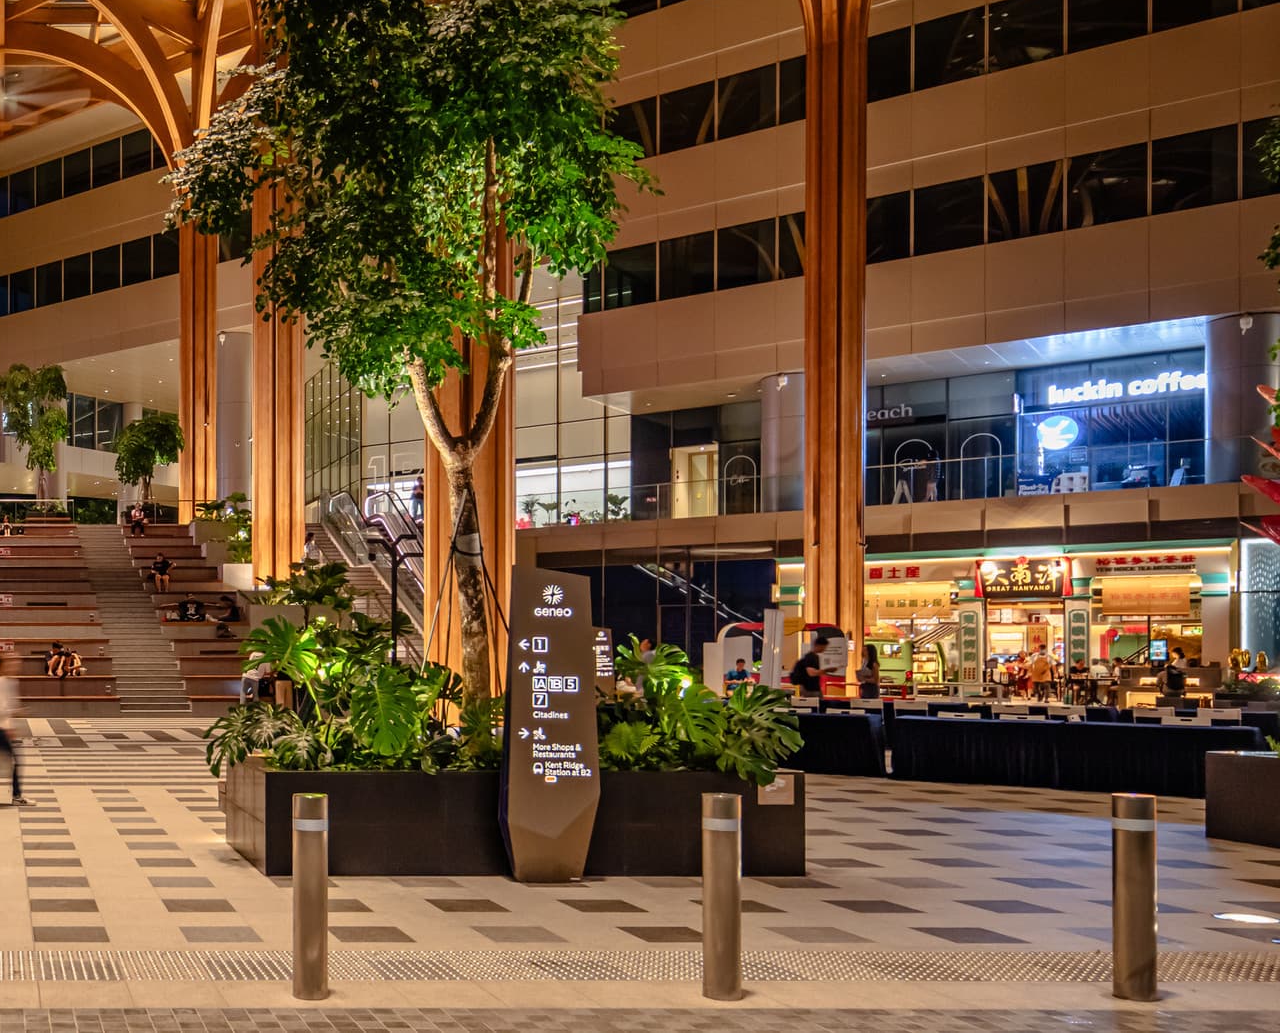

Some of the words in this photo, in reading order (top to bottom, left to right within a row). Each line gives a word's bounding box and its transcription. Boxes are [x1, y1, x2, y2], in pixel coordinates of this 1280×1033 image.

[1048, 380, 1123, 405] luckin
[532, 710, 568, 719] Citadines
[532, 743, 551, 751] More
[551, 743, 574, 752] Shops
[532, 750, 577, 759] Restaurants
[544, 761, 563, 769] Kent
[563, 761, 585, 770] Ridge
[544, 768, 571, 776] Station
[580, 768, 592, 776] B2
